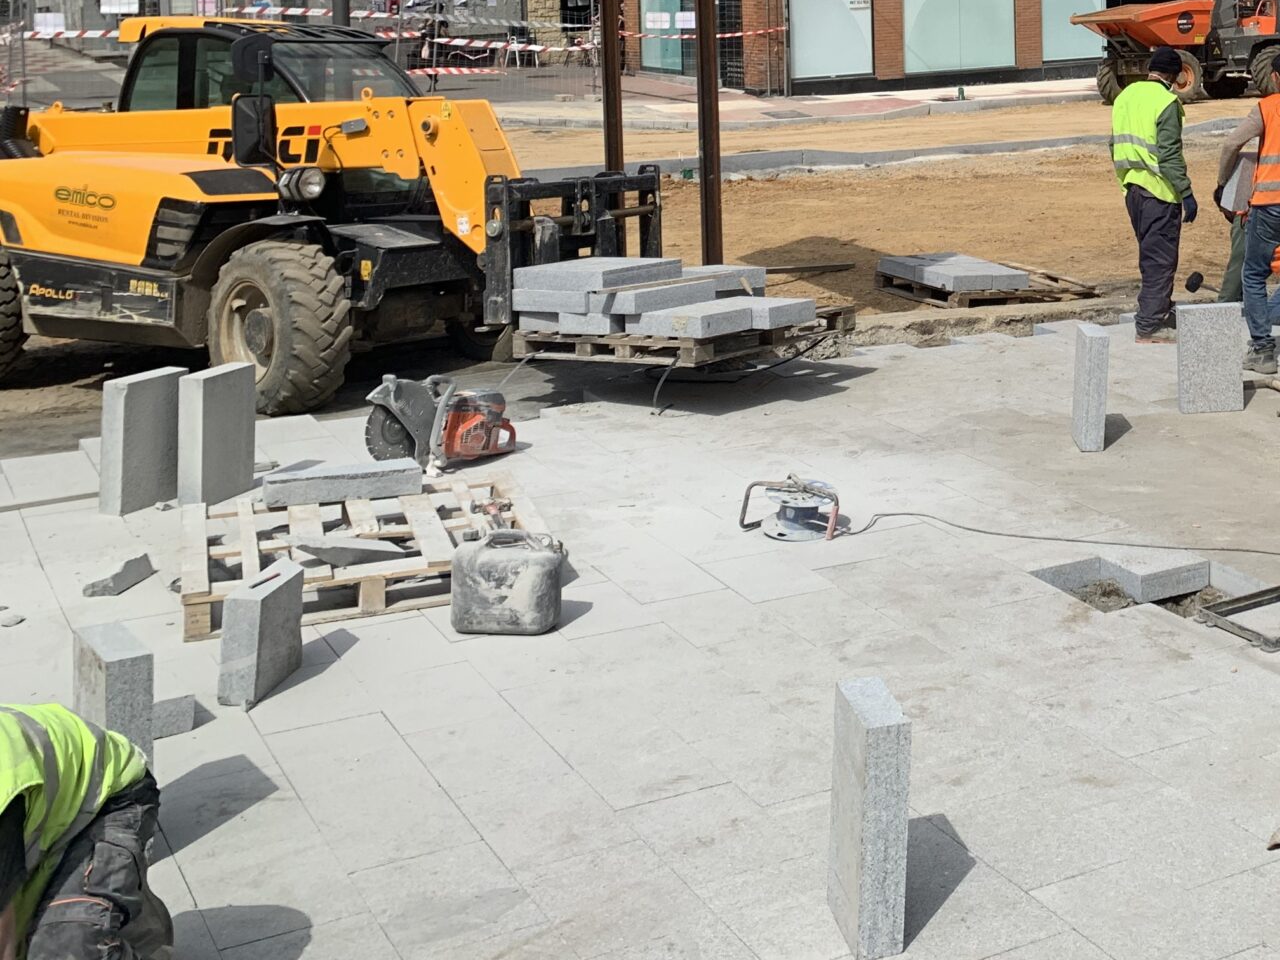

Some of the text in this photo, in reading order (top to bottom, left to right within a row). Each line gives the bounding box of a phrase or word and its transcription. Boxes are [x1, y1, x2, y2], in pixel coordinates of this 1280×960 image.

[54, 185, 117, 211] emico
[57, 208, 109, 223] RENTAL DIVISION
